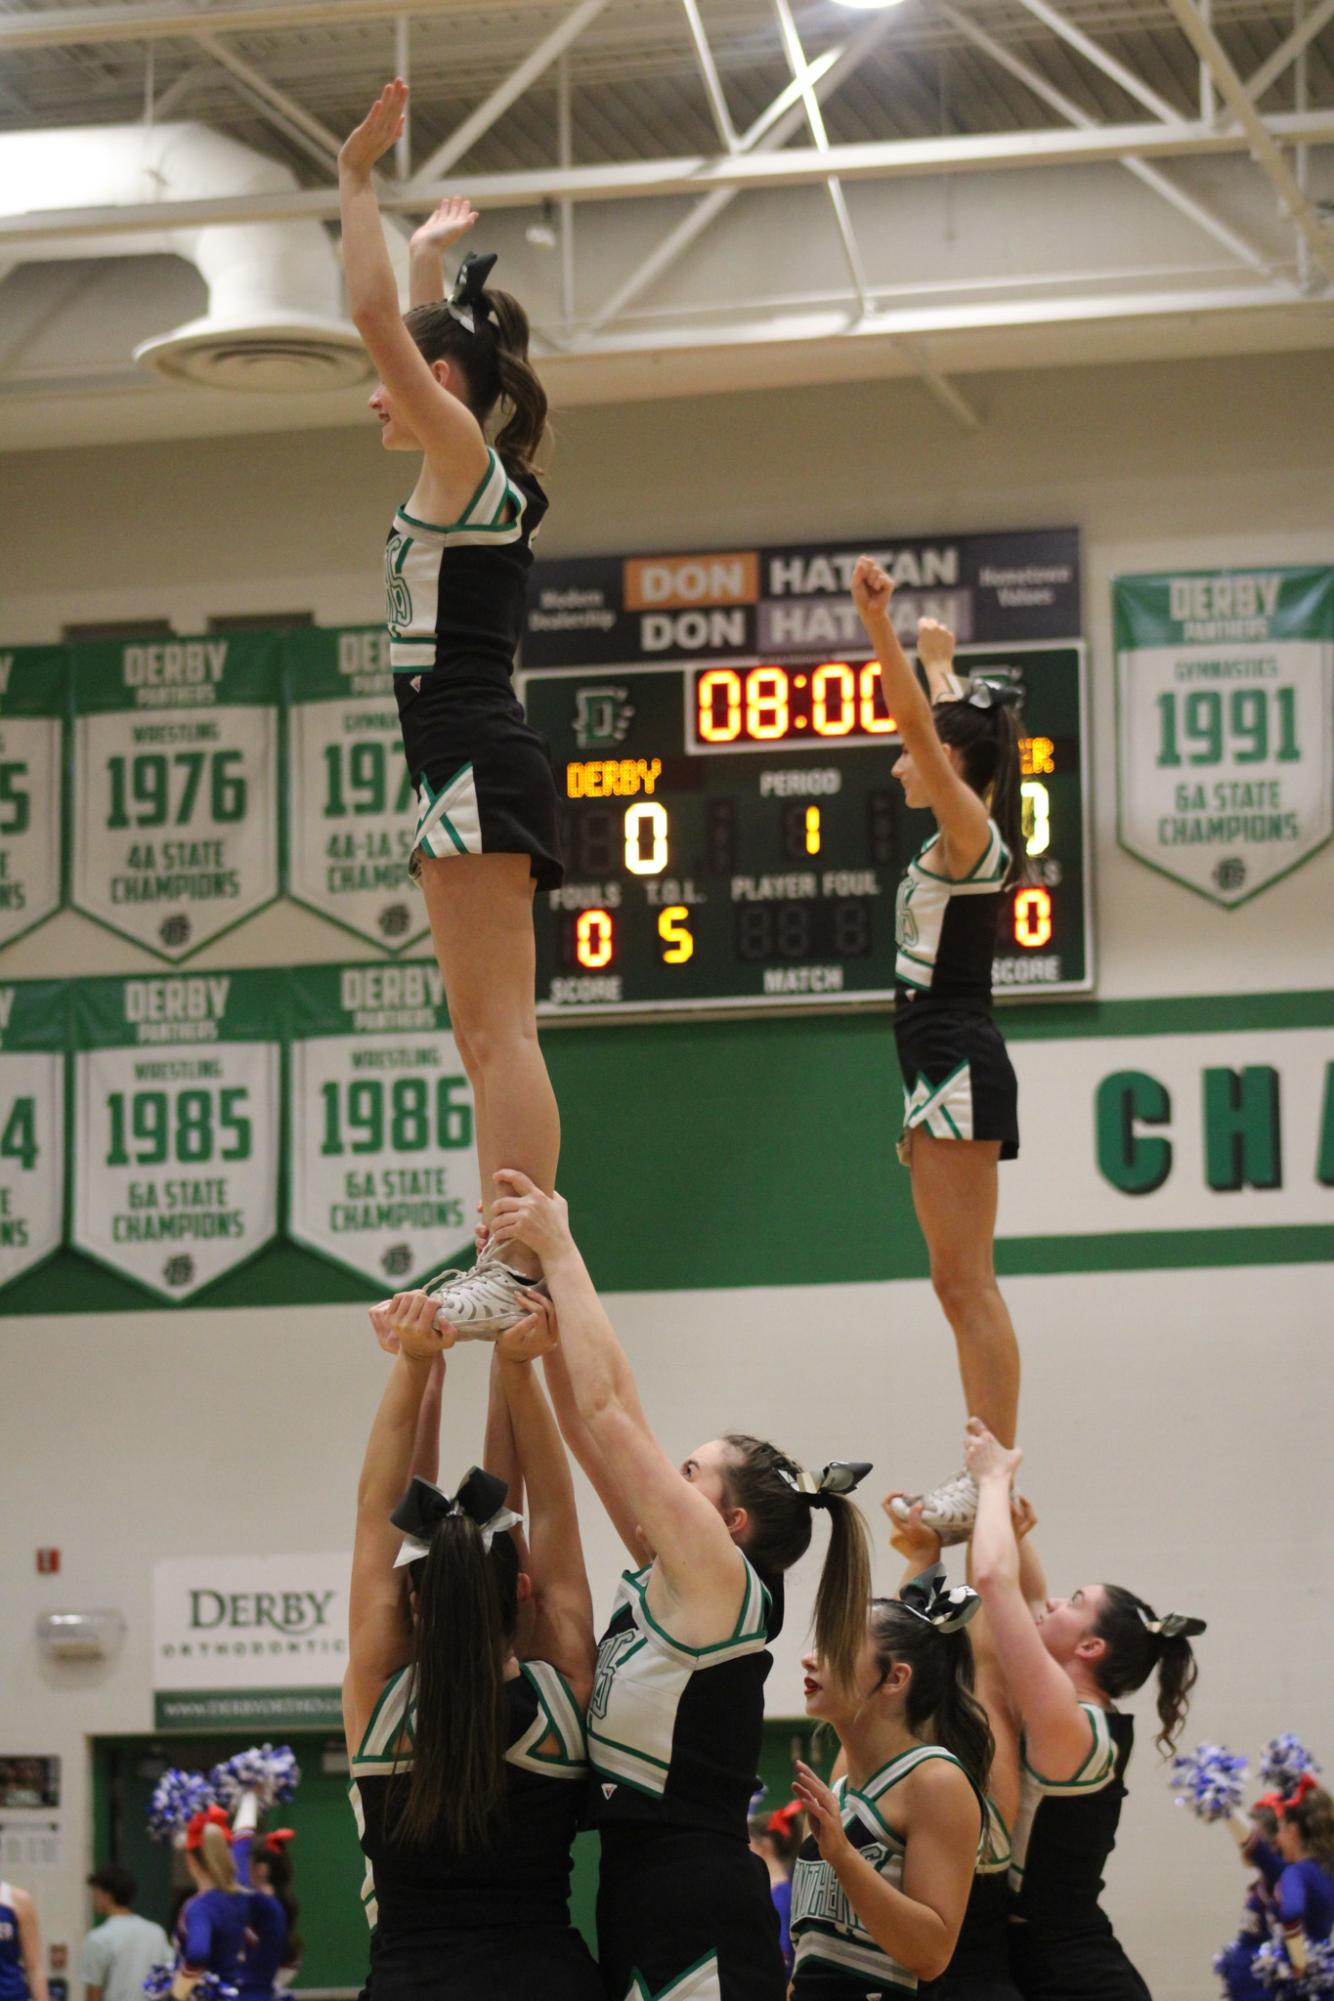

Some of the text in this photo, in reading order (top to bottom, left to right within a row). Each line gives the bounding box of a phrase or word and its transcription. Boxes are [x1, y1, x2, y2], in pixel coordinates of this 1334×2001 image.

[641, 563, 743, 602] DON
[1169, 576, 1282, 621] DERBY
[641, 592, 958, 650] DON HATAN
[124, 643, 227, 686] DERBY
[338, 633, 391, 675] DER
[1156, 685, 1301, 768] 1991
[106, 750, 248, 829] 1976
[324, 741, 411, 818] 197
[566, 758, 662, 798] DERBY
[760, 769, 841, 797] PERIOD
[1175, 780, 1280, 812] 6A STATE
[624, 801, 668, 875] 0
[806, 805, 821, 855] 1
[1157, 813, 1298, 846] CHAMPIONS
[128, 839, 225, 871] 4A STATE
[110, 870, 240, 905] CHAMPIONS
[731, 870, 881, 900] PLAYER FOUL
[658, 906, 693, 964] 5
[1014, 887, 1051, 947] 0
[577, 909, 612, 968] 0
[125, 975, 230, 1022] DERBY
[341, 966, 446, 1010] DERBY
[550, 976, 622, 1004] SCORE
[763, 966, 844, 995] MATCH
[106, 1085, 251, 1167] 1985
[321, 1075, 473, 1156] 1986
[1095, 1060, 1334, 1195] CH
[129, 1178, 227, 1210] 6A STATE
[345, 1167, 446, 1200] 6A STATE
[112, 1209, 244, 1244] CHAMPIONS
[329, 1199, 464, 1233] CHAMPIONS
[162, 1638, 346, 1660] ORTHODONTIC
